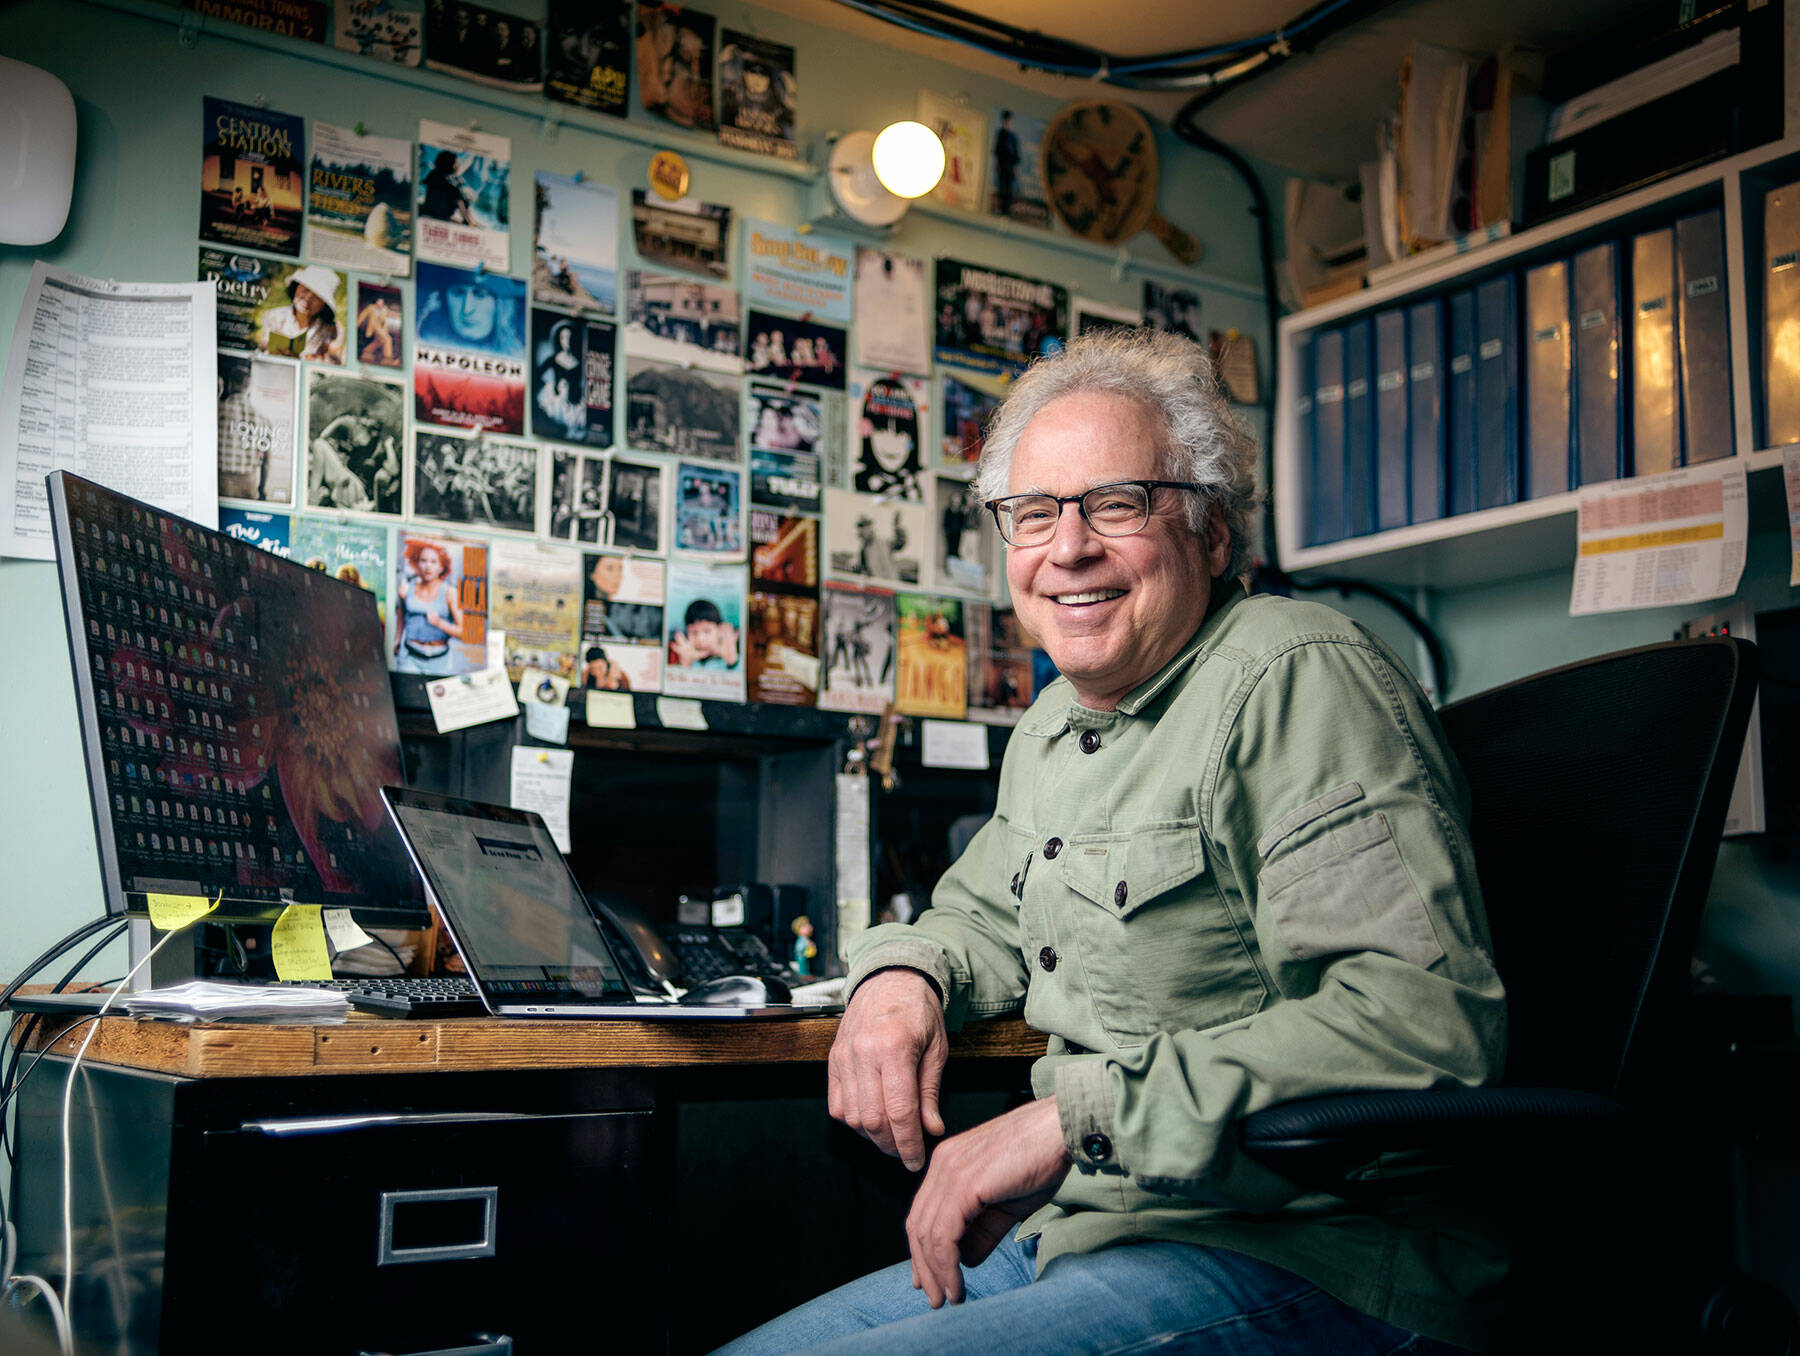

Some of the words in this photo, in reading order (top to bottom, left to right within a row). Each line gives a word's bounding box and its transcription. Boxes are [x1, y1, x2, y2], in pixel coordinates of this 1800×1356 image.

[216, 115, 288, 145] CENTRAL
[217, 129, 293, 159] STATION
[312, 169, 375, 193] RIVERS
[207, 271, 271, 305] Poetry
[417, 352, 521, 375] NAPOLEON
[231, 421, 288, 438] LOVING
[241, 437, 288, 452] STORY
[226, 523, 260, 541] The
